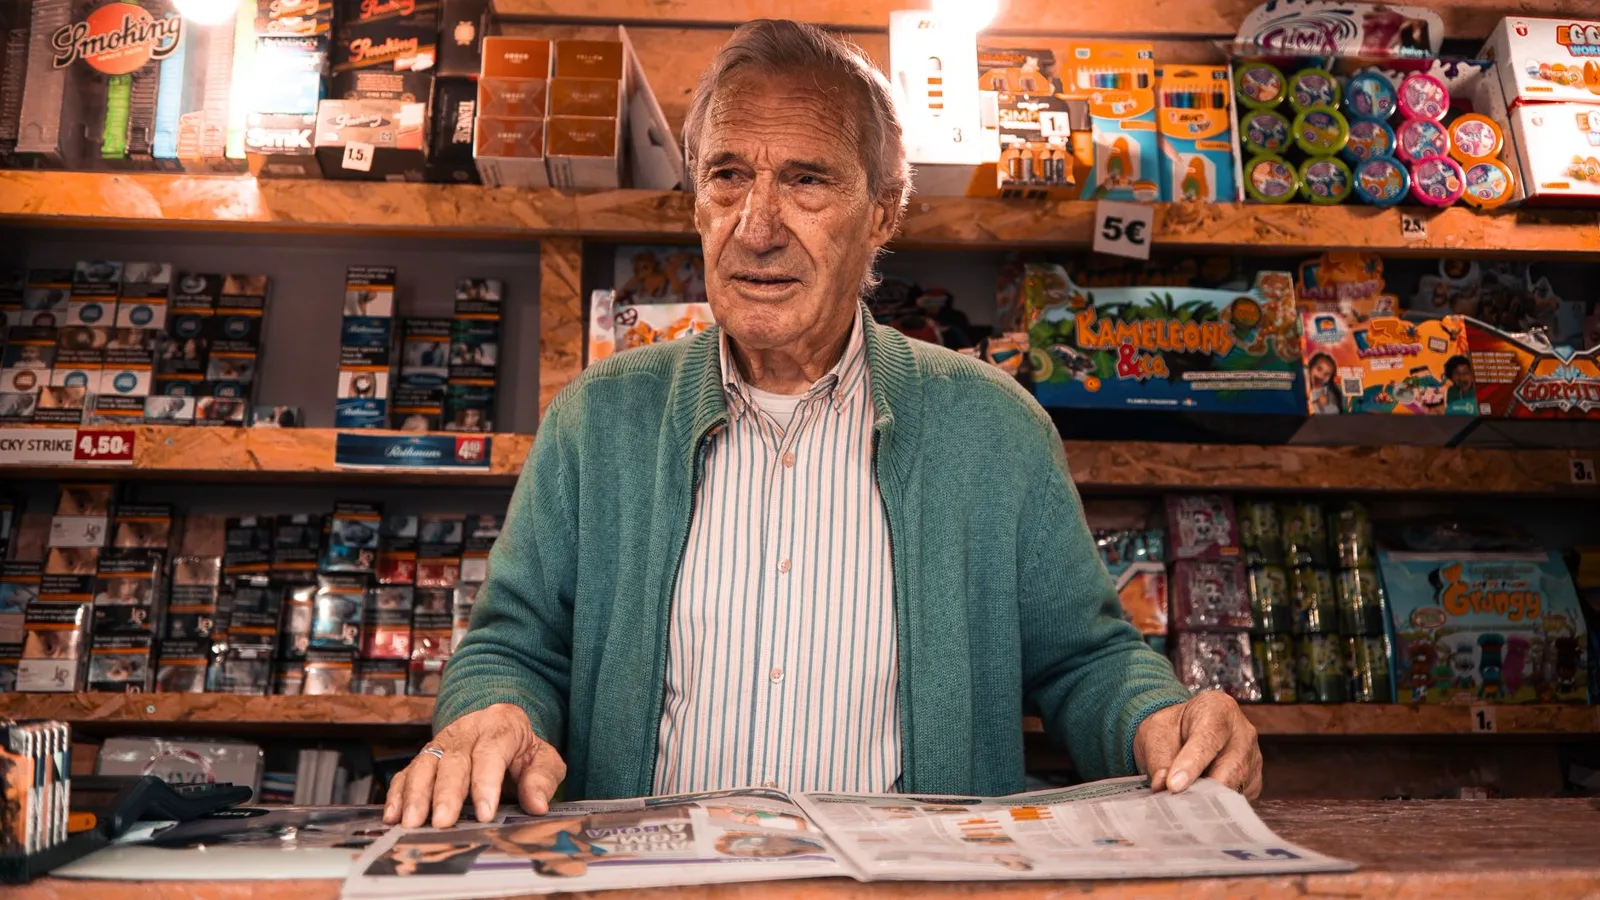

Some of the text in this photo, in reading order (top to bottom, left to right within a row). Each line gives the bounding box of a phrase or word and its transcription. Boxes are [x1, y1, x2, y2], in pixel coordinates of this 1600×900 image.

[52, 14, 182, 68] Smoking
[1102, 215, 1146, 245] 5€
[1075, 306, 1236, 357] KAMELEONS
[27, 439, 73, 452] STRIKE
[385, 445, 443, 459] Rothmans
[1443, 578, 1542, 622] Grungy
